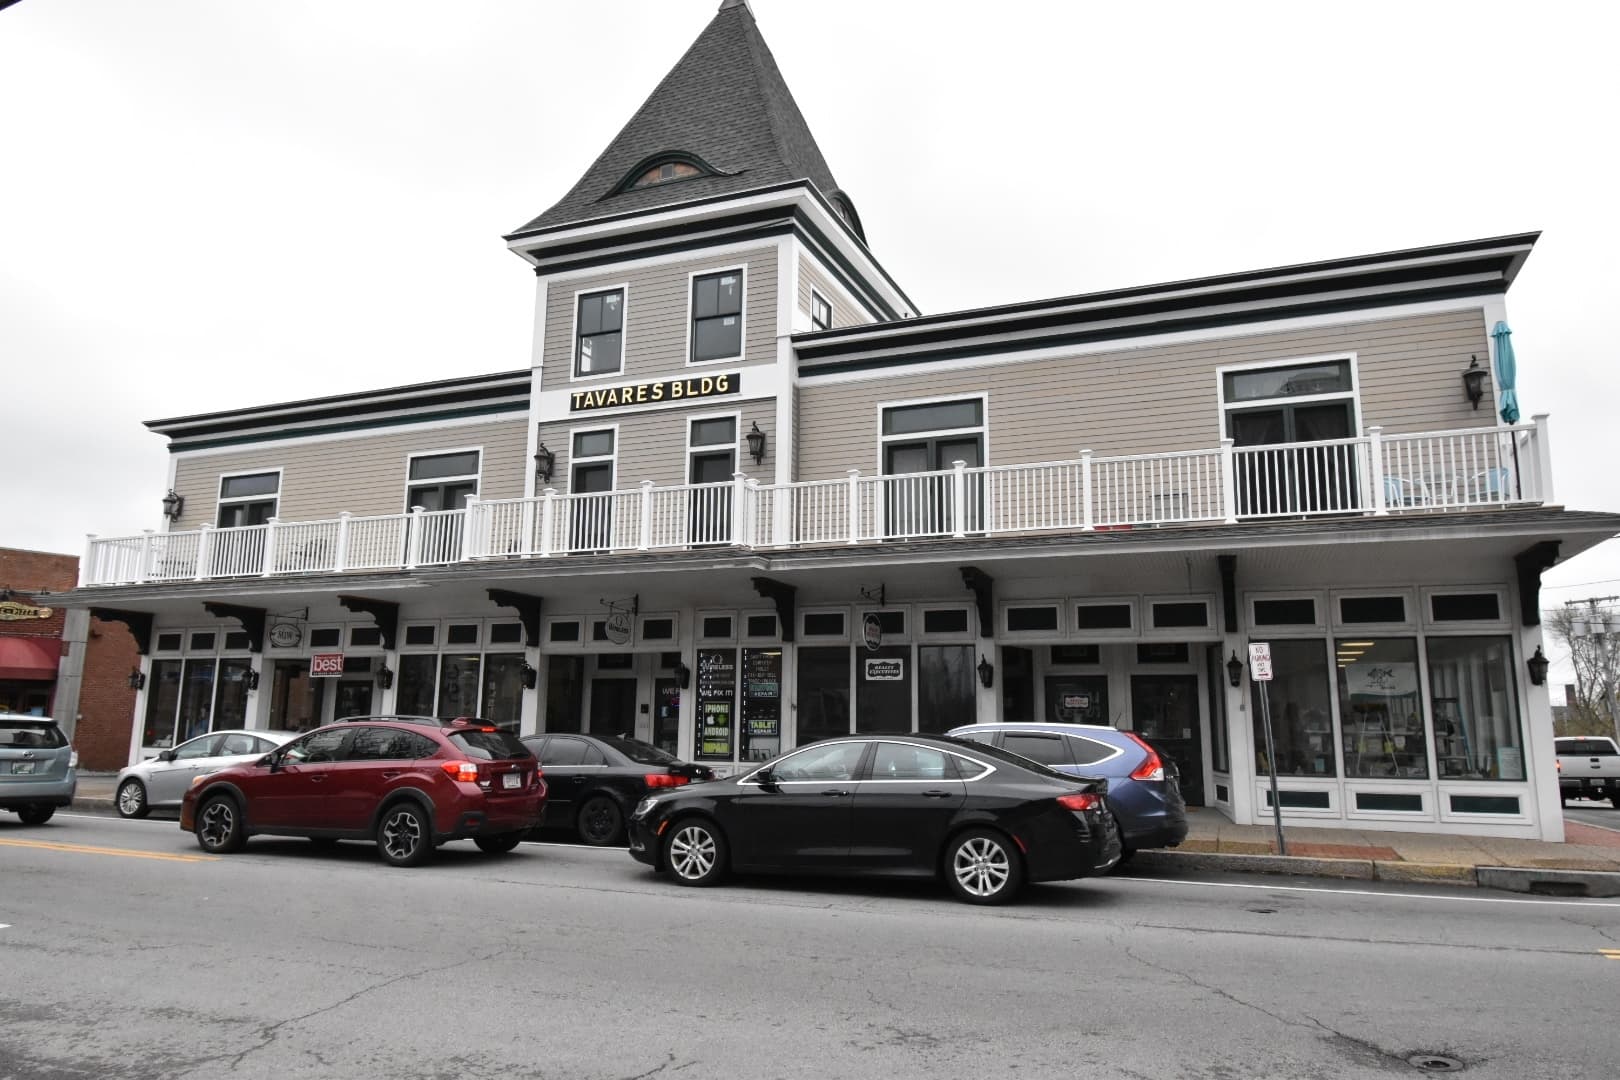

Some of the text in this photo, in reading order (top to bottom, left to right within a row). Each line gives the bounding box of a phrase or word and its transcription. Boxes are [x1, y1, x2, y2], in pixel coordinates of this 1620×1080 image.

[572, 375, 729, 408] TAVARES BLDG
[314, 655, 342, 672] best
[705, 704, 729, 713] IPHONE
[751, 721, 776, 729] TABLET
[704, 727, 729, 736] ANDROID
